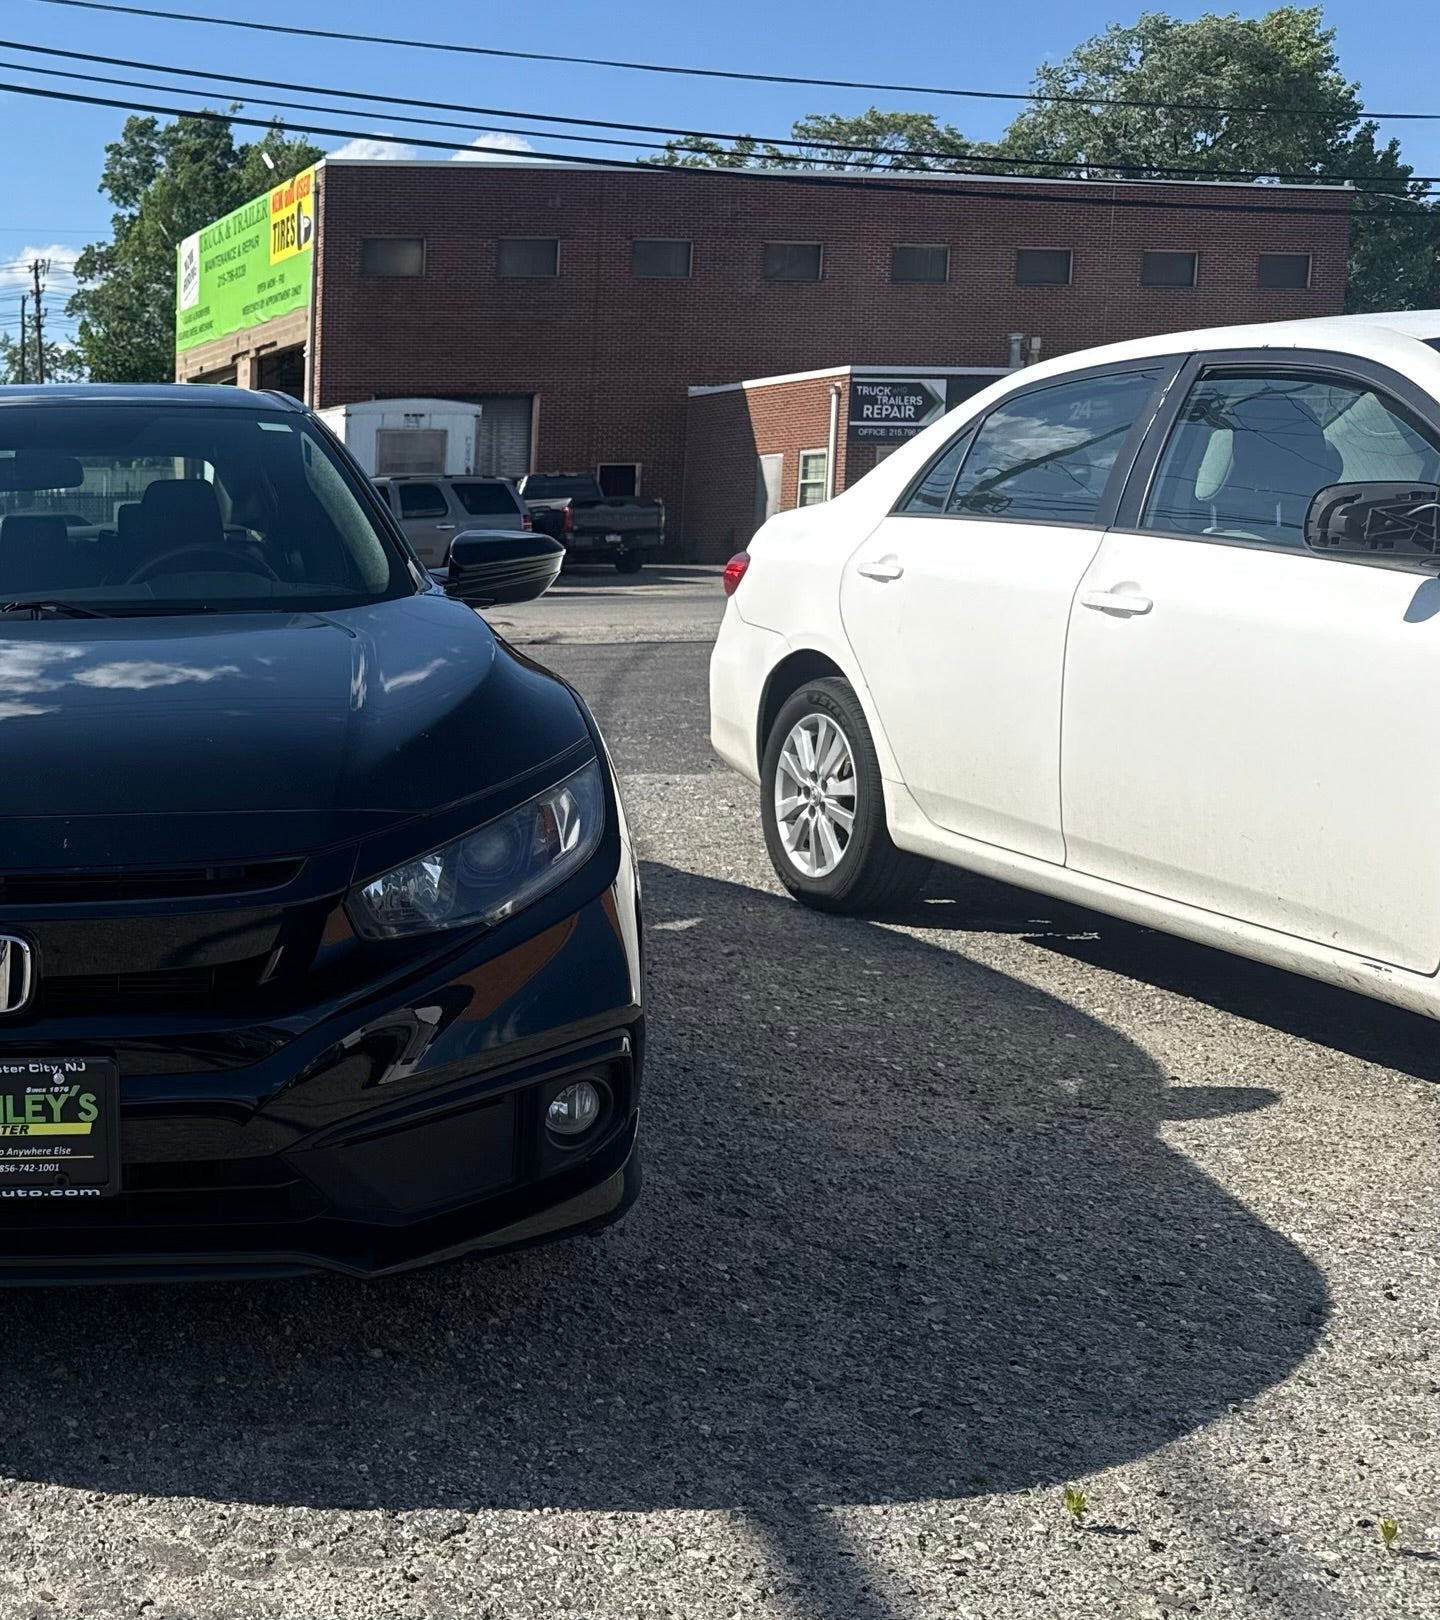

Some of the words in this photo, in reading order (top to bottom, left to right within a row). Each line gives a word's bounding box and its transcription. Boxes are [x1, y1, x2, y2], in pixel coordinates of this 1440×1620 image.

[199, 224, 223, 254] TRUCK
[225, 217, 231, 240] &
[232, 198, 268, 235] TRAILER
[272, 213, 296, 255] TIRES
[205, 248, 236, 273] MAINTENANCE
[242, 234, 259, 254] REPAIR
[856, 385, 892, 396] TRUCK
[876, 396, 923, 406] TRAILERS
[863, 405, 915, 418] REPAIR
[858, 427, 888, 436] OFFICE:
[28, 1063, 62, 1074] City,
[65, 1062, 85, 1072] NJ
[6, 1147, 51, 1158] Anywhere
[53, 1146, 71, 1156] Else
